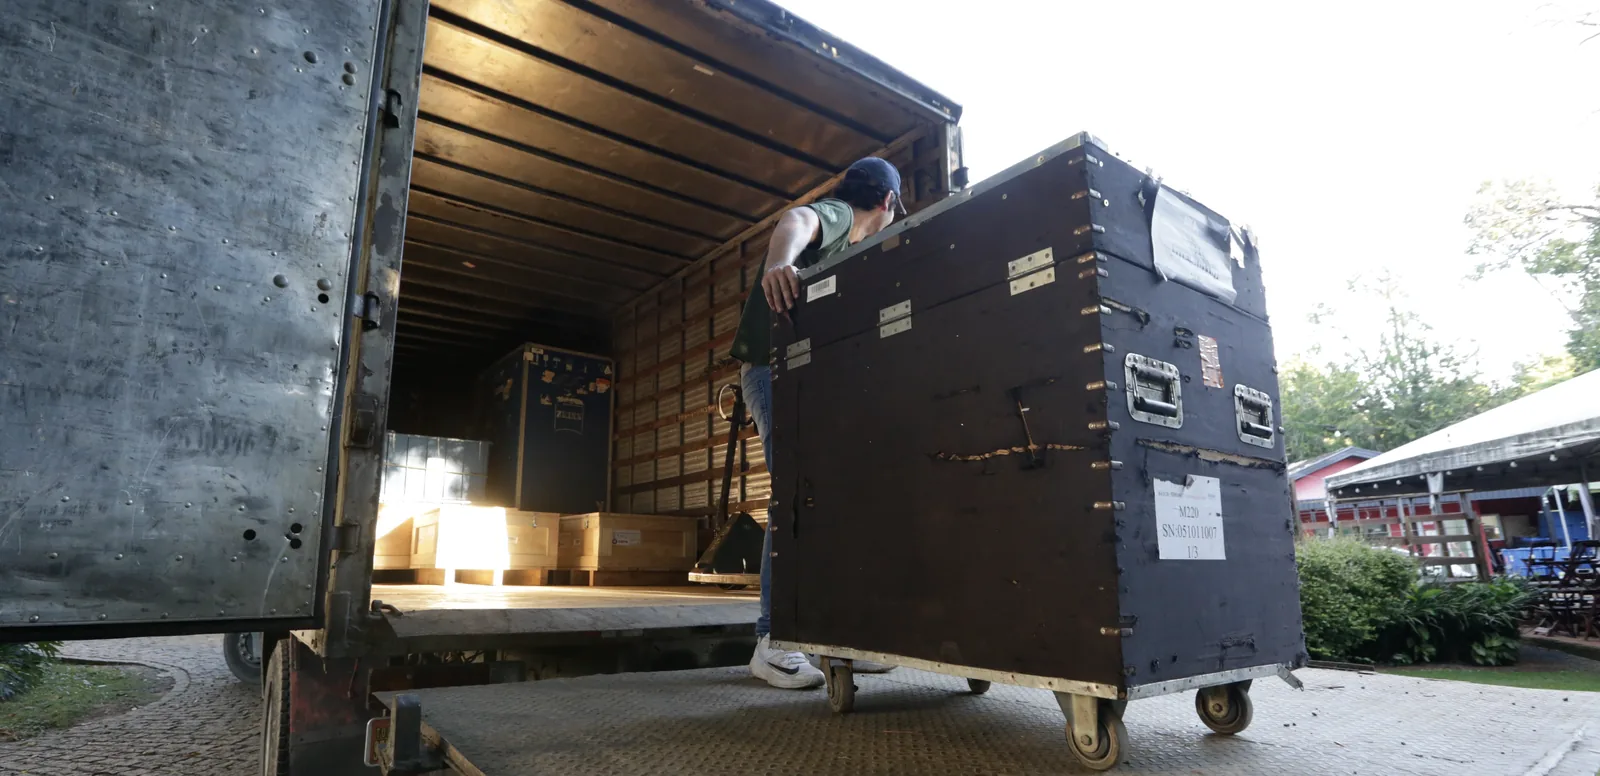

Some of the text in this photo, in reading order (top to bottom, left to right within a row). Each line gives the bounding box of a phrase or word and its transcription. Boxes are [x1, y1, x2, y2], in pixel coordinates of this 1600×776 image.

[1179, 505, 1199, 518] M220
[1162, 523, 1217, 539] SN:051011007
[1187, 545, 1199, 559] 1/3
